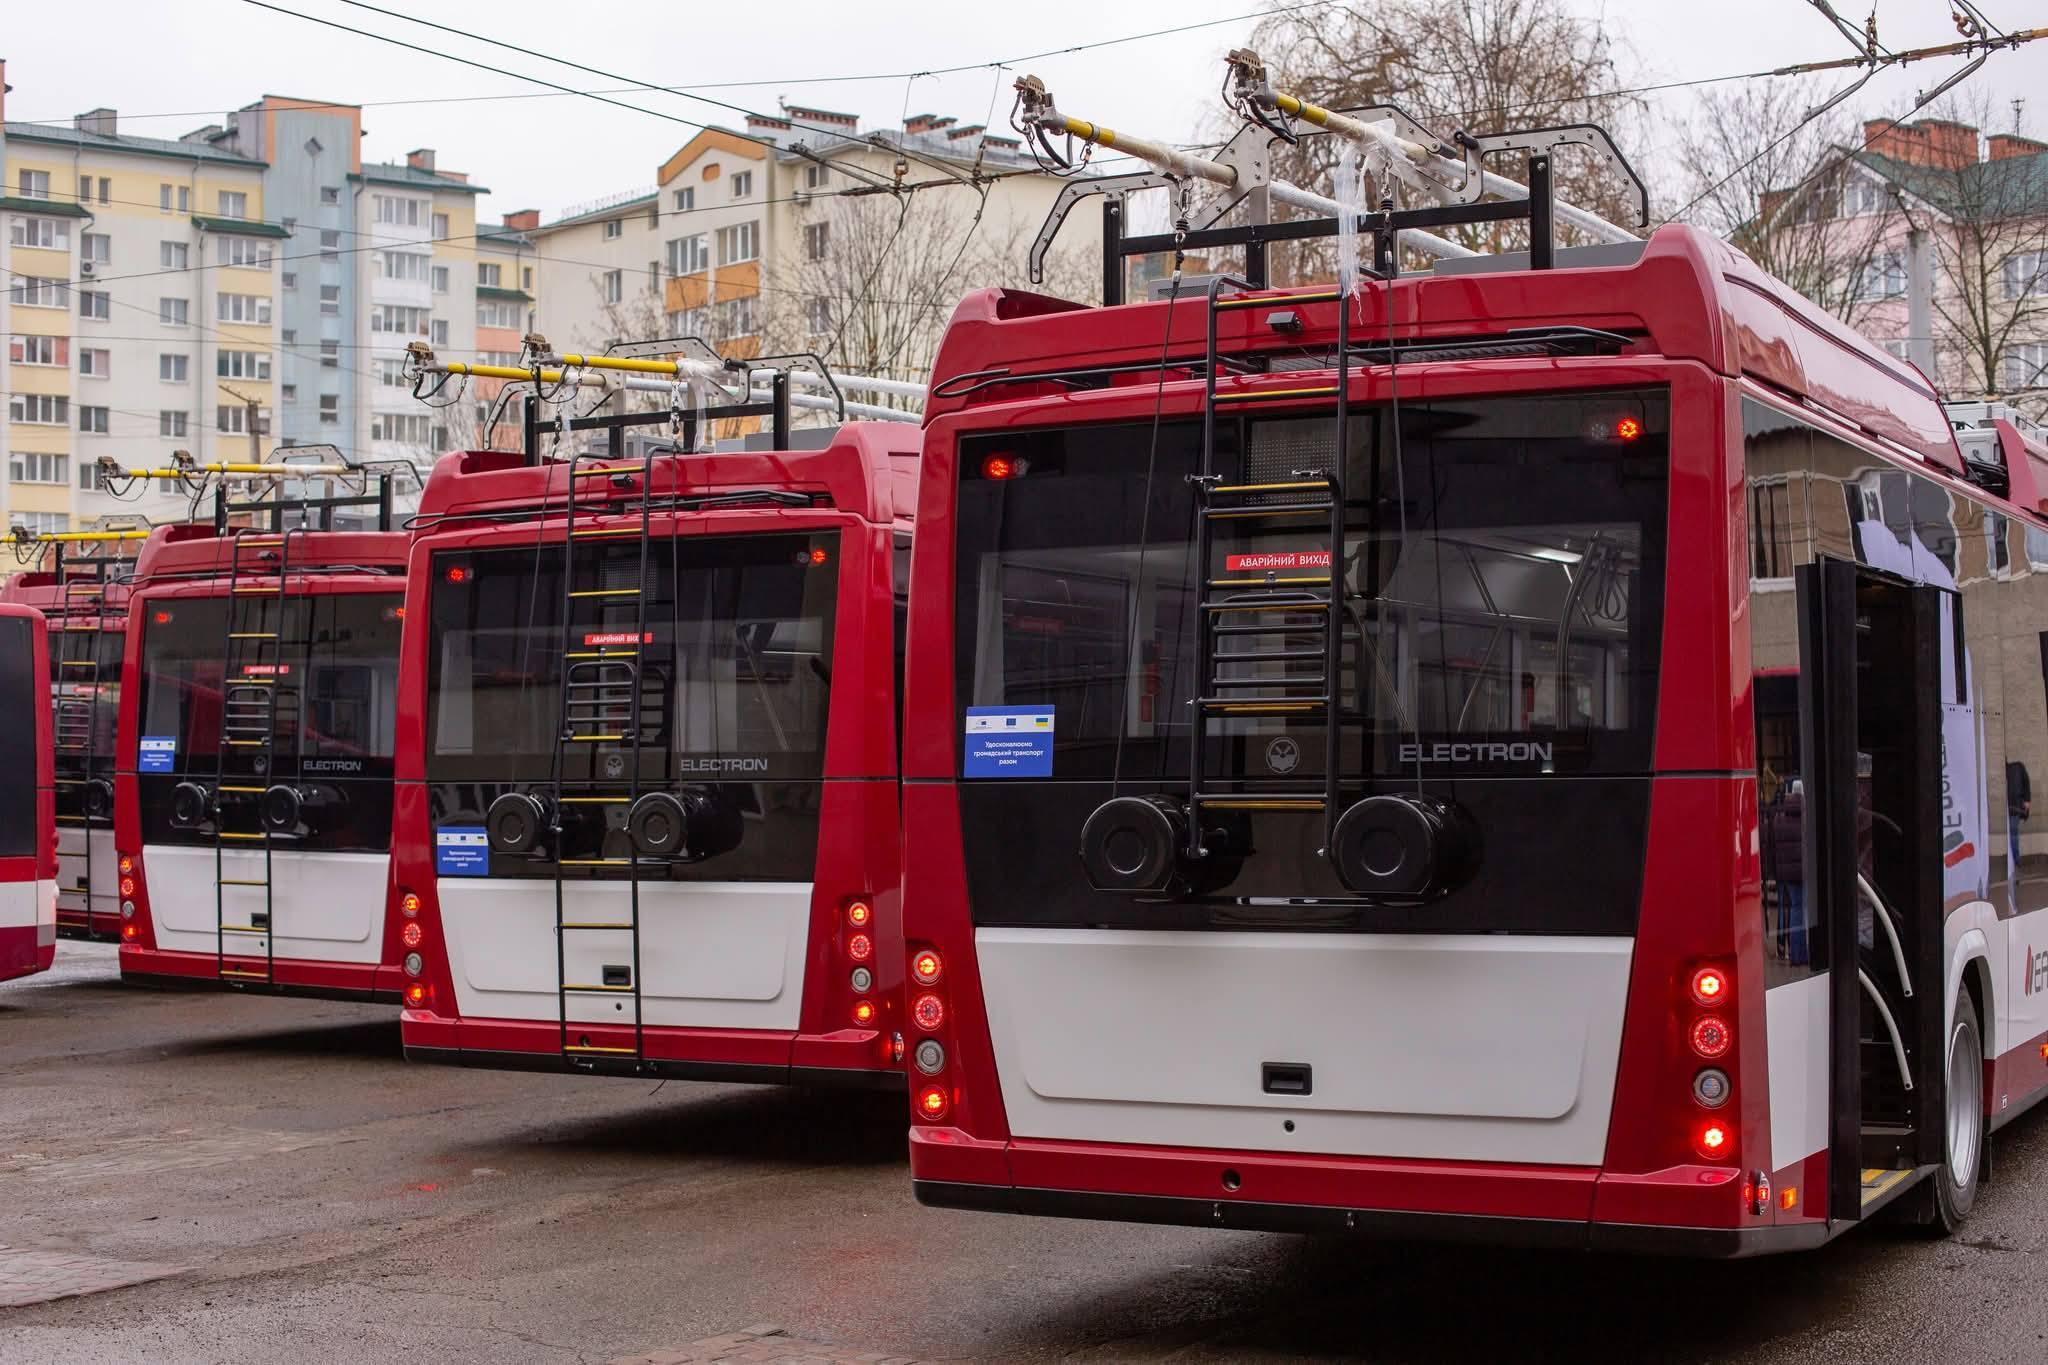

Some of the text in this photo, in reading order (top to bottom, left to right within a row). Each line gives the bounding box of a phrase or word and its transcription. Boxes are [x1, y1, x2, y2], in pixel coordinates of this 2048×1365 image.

[1240, 554, 1330, 567] АВАРІЙНИЙ ВИХІД
[973, 749, 1012, 757] громадський
[1399, 742, 1553, 762] ELECTRON
[303, 760, 362, 771] ELECTRON
[680, 758, 769, 772] ELECTRON
